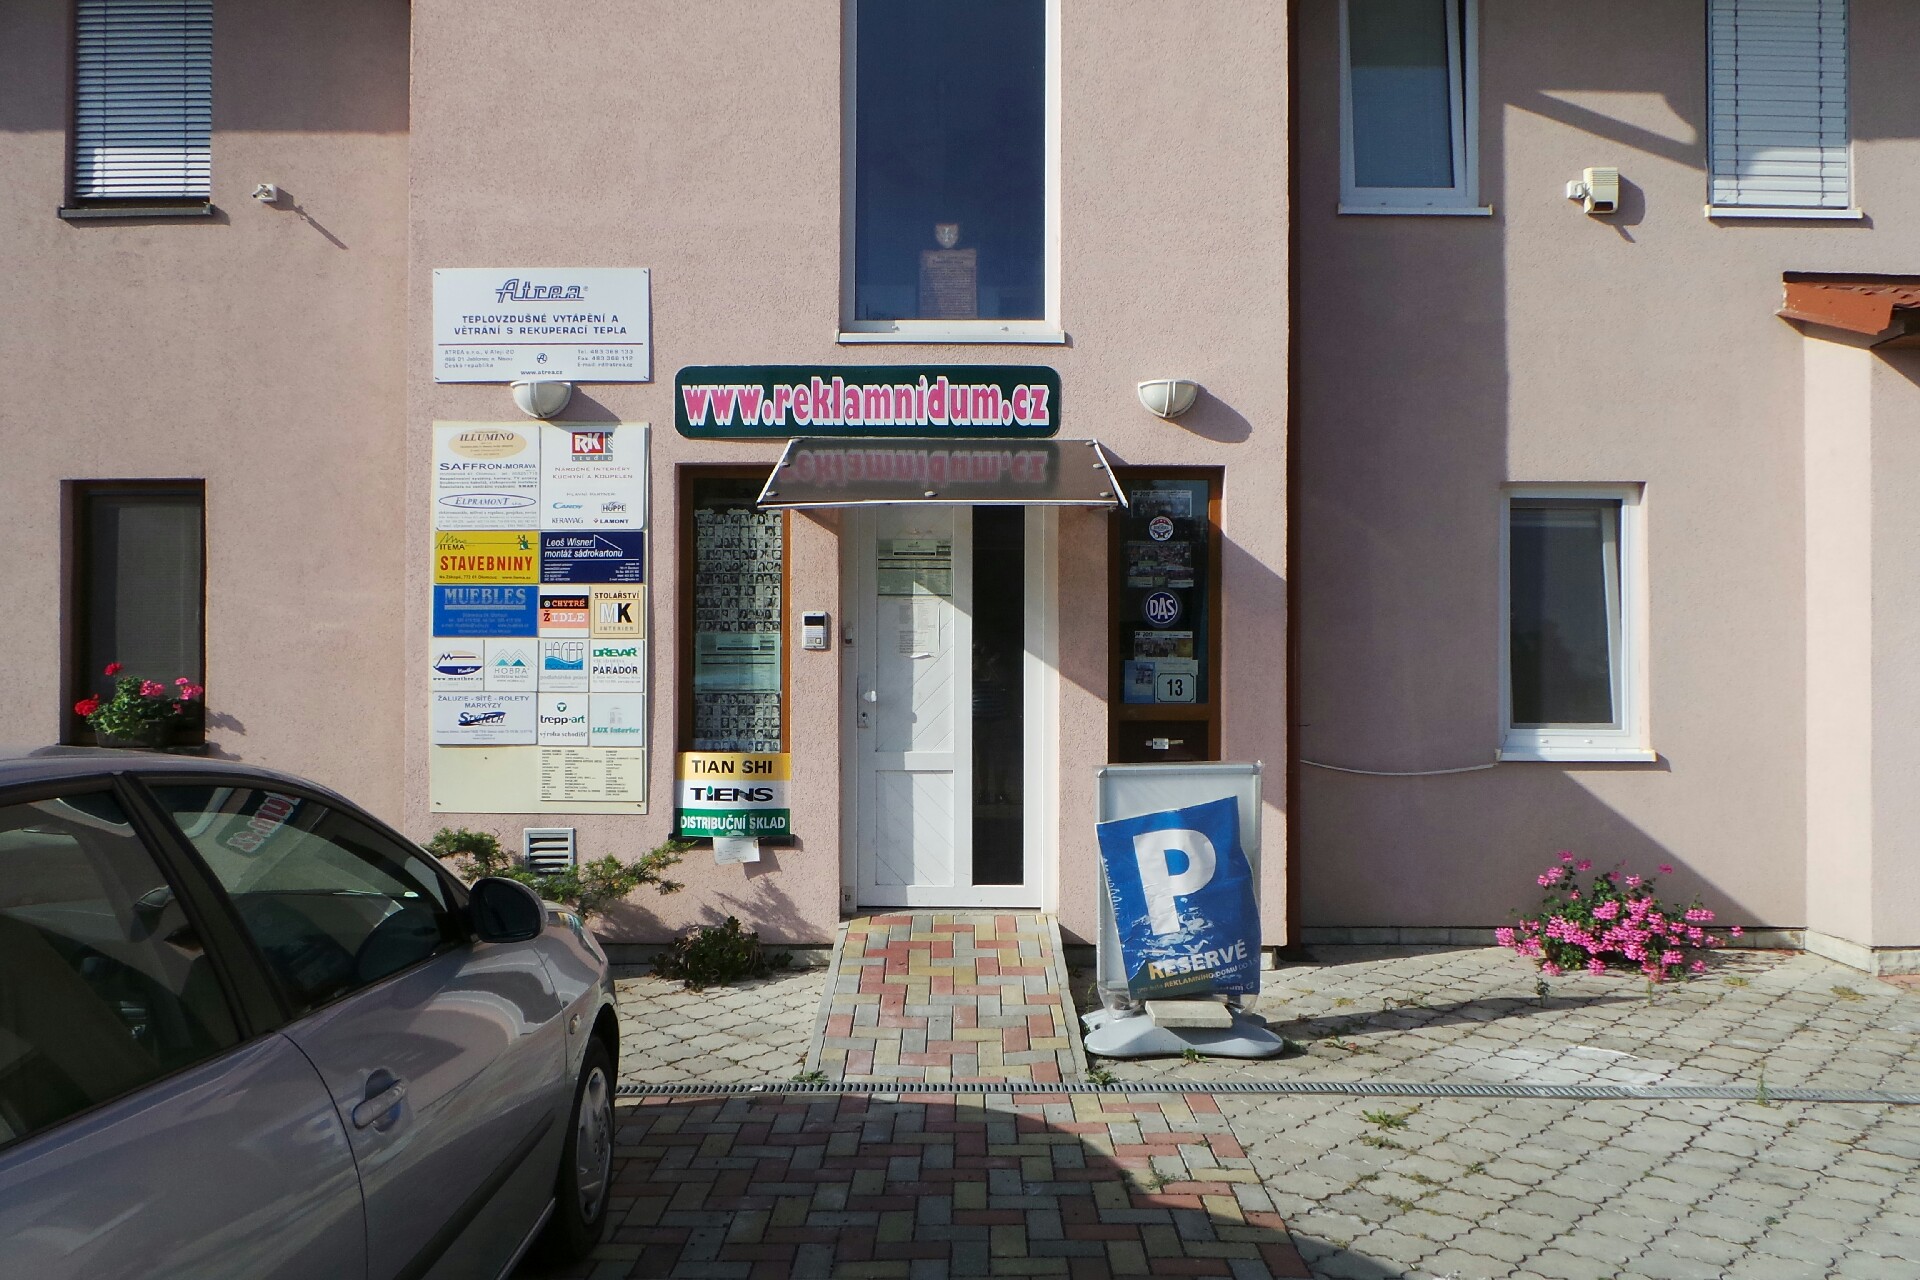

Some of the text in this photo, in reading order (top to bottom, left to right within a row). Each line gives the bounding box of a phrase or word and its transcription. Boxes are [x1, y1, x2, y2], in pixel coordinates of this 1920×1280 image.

[462, 313, 619, 324] TEPLOVZDUŠNÉ VYTÁPĚNÍ A
[454, 325, 627, 335] VĚTRÁNÍ S REKUPERACÍ TEPLA
[681, 374, 1050, 427] www.reklamnidum.cz
[460, 432, 514, 442] ILLUMINO
[574, 432, 602, 453] RK
[439, 462, 536, 471] SAFFRON-MORAVA
[455, 496, 511, 505] ELPRAMONT
[546, 537, 594, 547] Leoš Wisner
[544, 548, 623, 558] montáž sádrokartonu
[440, 555, 533, 571] STAVEBNINY
[444, 588, 526, 605] MUEBLES
[594, 590, 640, 599] STOLAŘSTVÍ
[551, 598, 585, 607] CHYTRÉ
[600, 603, 633, 623] MK
[1149, 597, 1175, 620] DAS
[543, 609, 585, 622] ŽIDLE
[494, 667, 528, 675] HOBRA
[592, 666, 638, 674] PARADOR
[1166, 678, 1183, 697] 13
[437, 694, 469, 702] ŽALUZIE
[475, 694, 491, 702] SÍTĚ
[692, 760, 773, 774] TIAN SHI
[680, 814, 786, 830] DISTRIBUČNÍ SKLAD
[1133, 828, 1217, 936] P
